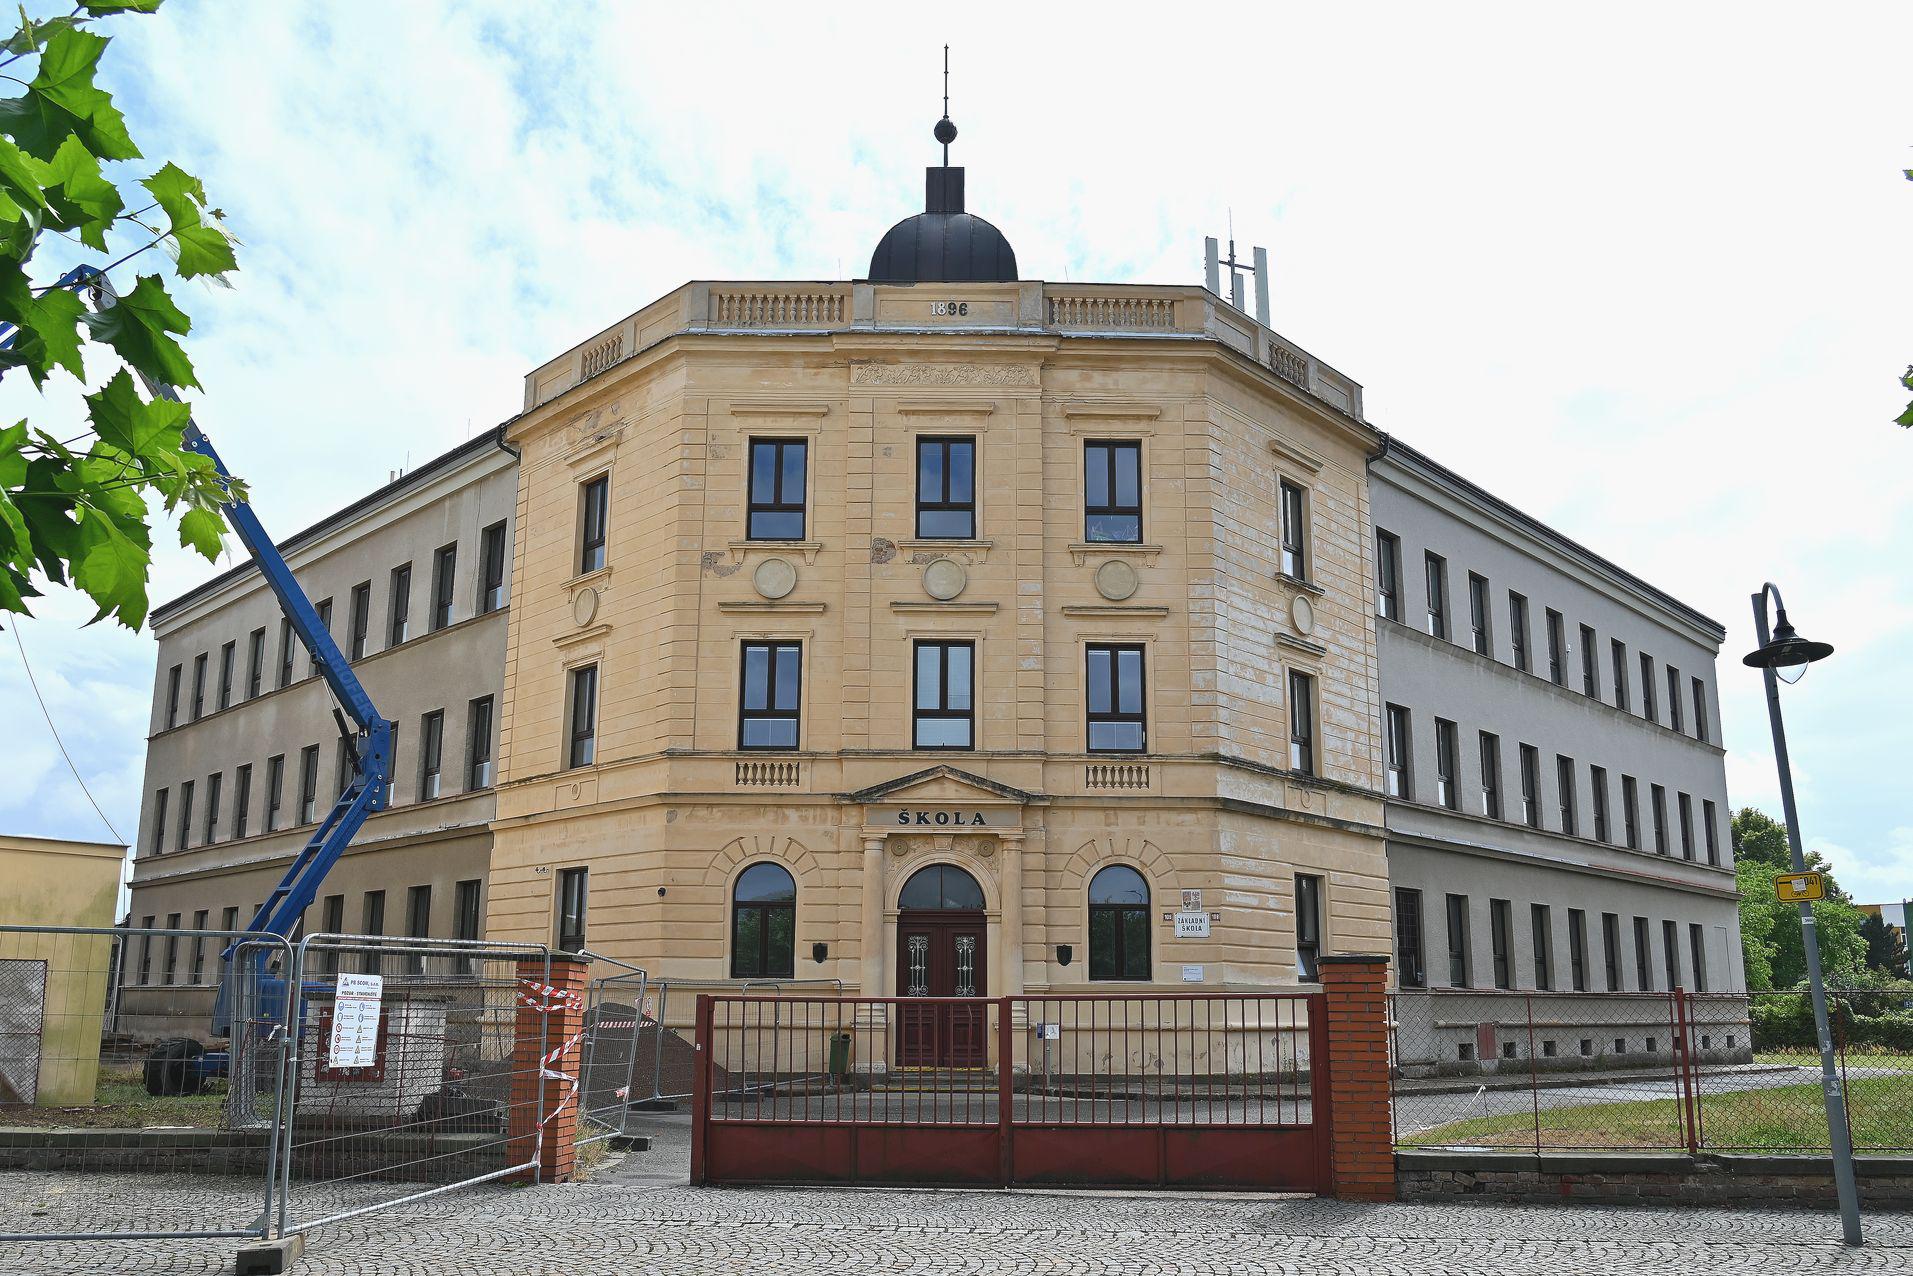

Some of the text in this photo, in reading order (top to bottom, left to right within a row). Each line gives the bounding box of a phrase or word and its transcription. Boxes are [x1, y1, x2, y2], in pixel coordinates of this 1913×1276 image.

[931, 302, 968, 316] 1896
[898, 808, 986, 825] ŠKOLA
[1177, 916, 1206, 924] ZÁKLADNÍ
[1181, 924, 1202, 932] ŠKOLA
